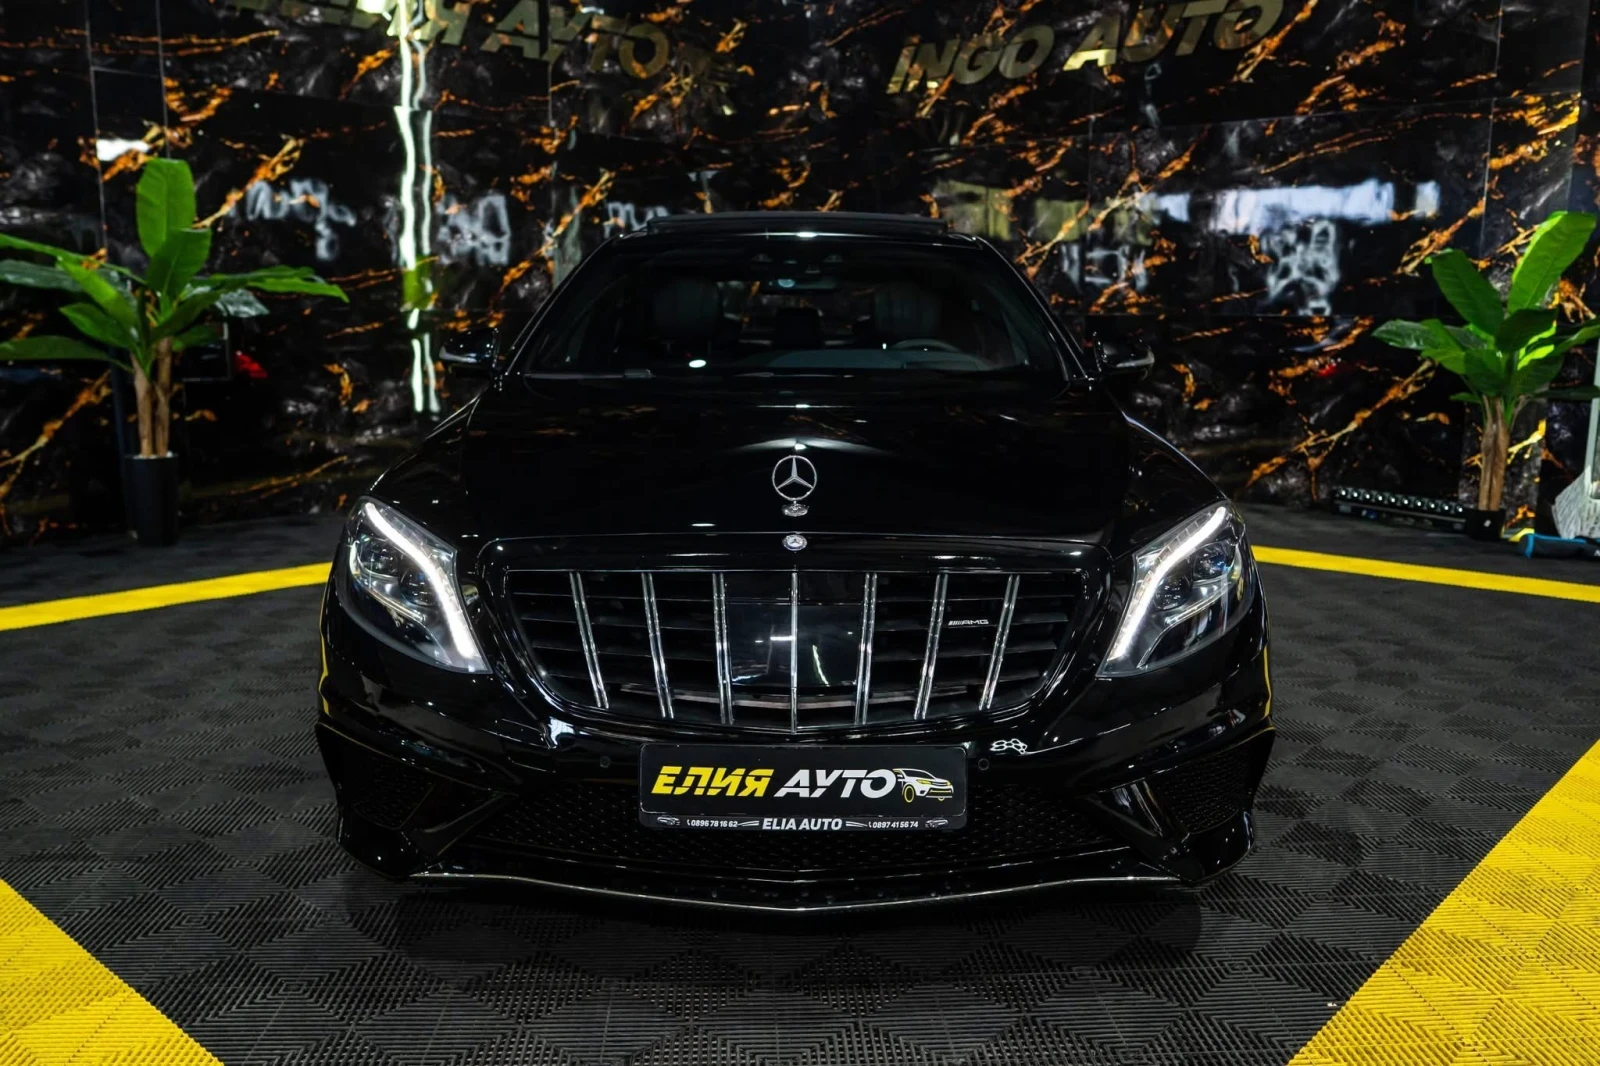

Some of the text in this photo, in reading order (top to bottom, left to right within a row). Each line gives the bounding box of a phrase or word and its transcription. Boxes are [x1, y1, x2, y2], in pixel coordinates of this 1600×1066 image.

[886, 0, 1284, 94] INGO AUTO
[651, 765, 896, 799] ЕЛИЯ АУТО
[762, 818, 796, 830] ELIA
[798, 818, 842, 830] AUTO
